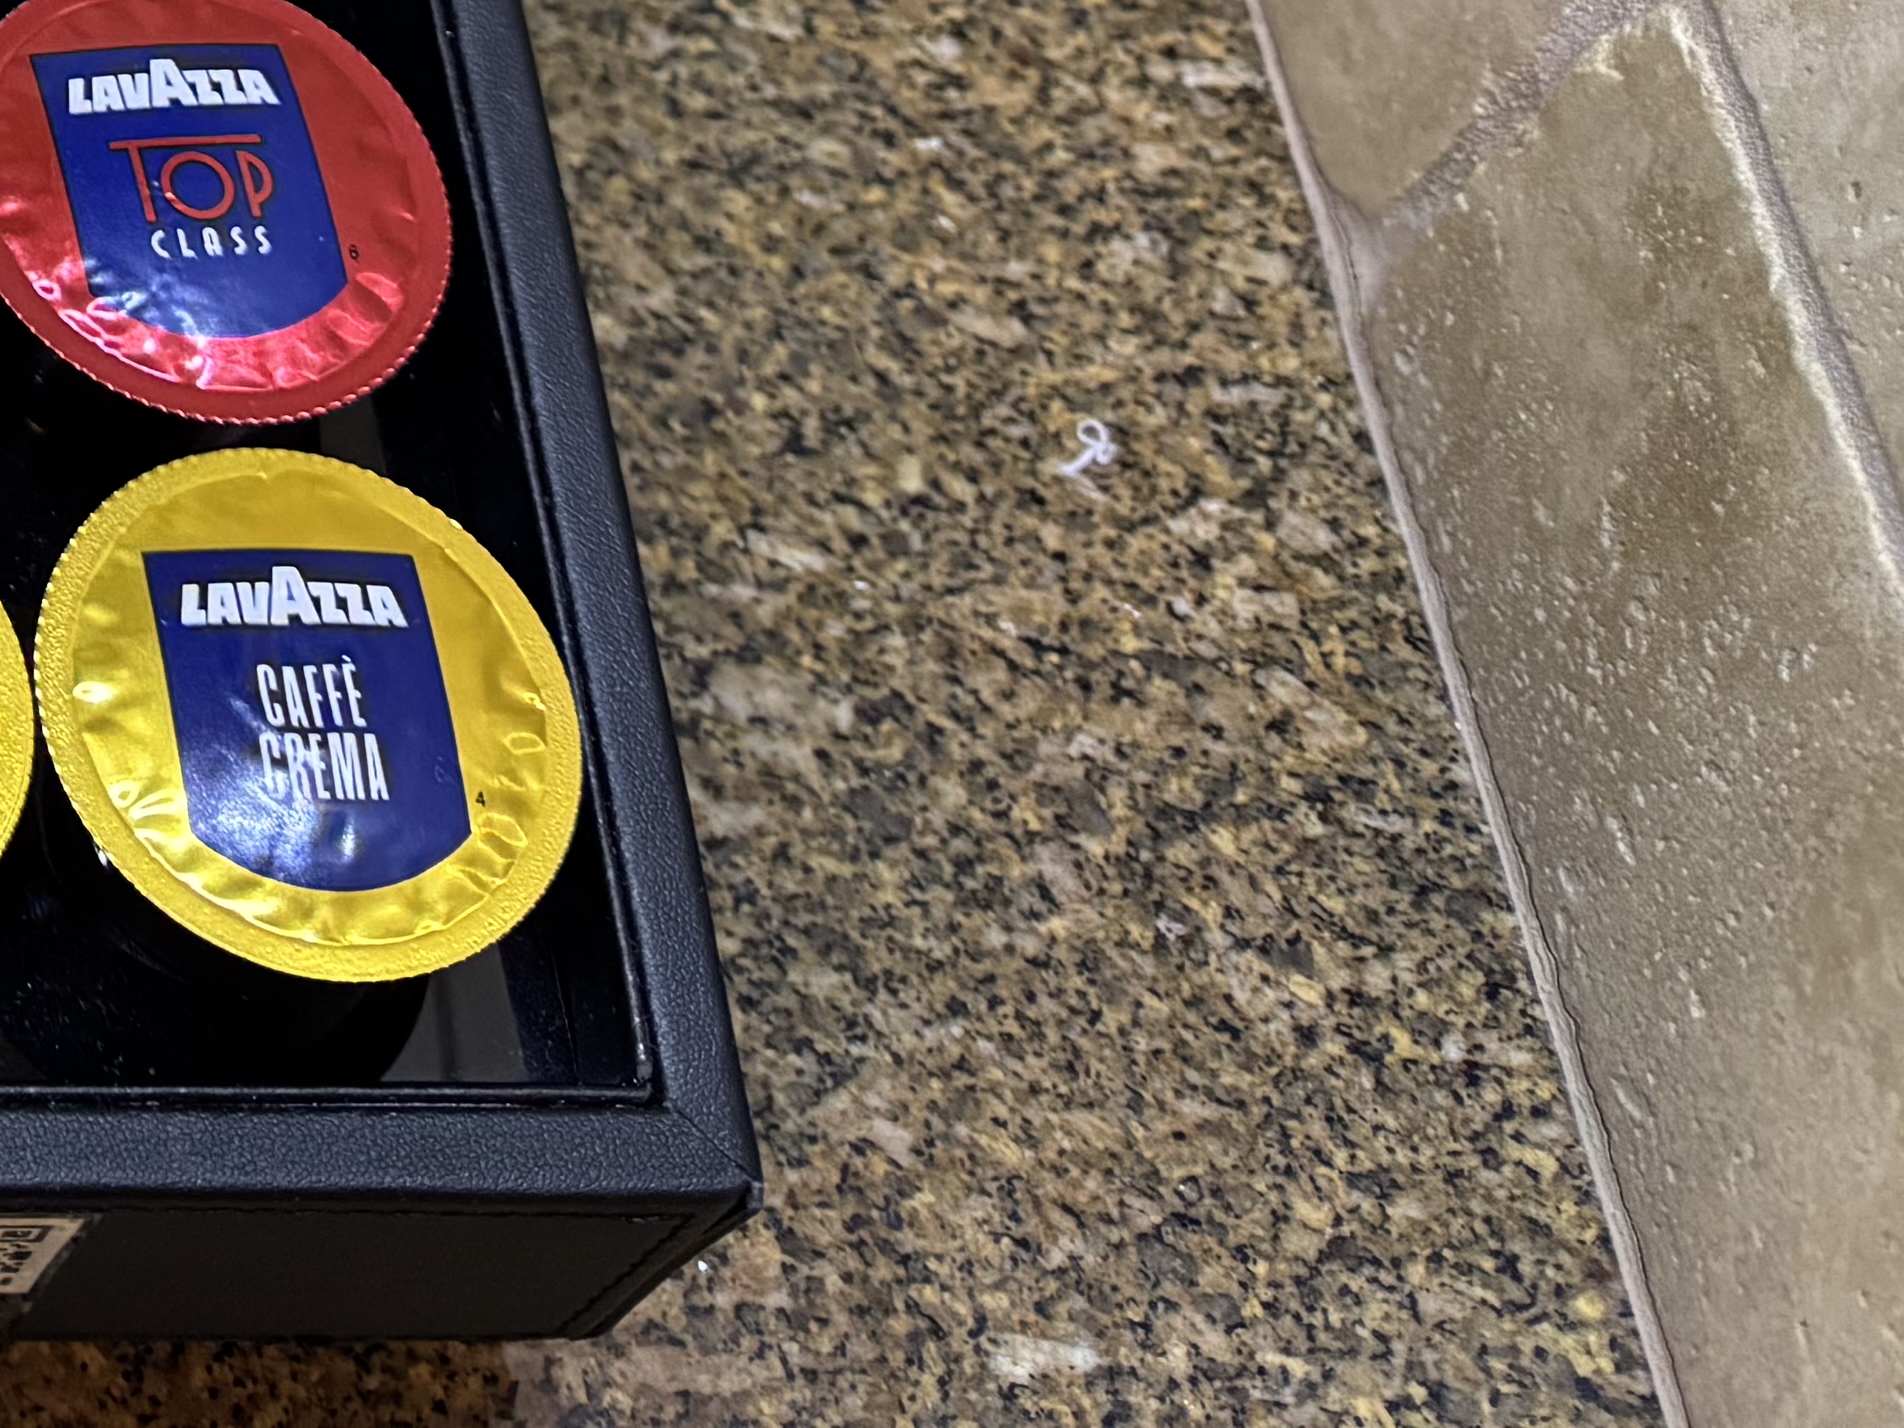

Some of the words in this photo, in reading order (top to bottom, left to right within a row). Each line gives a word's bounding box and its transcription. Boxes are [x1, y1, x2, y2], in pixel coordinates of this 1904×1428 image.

[109, 134, 274, 223] TOP
[150, 225, 272, 259] CLASS
[256, 655, 367, 728] CAFFÈ
[259, 732, 390, 801] CREMA
